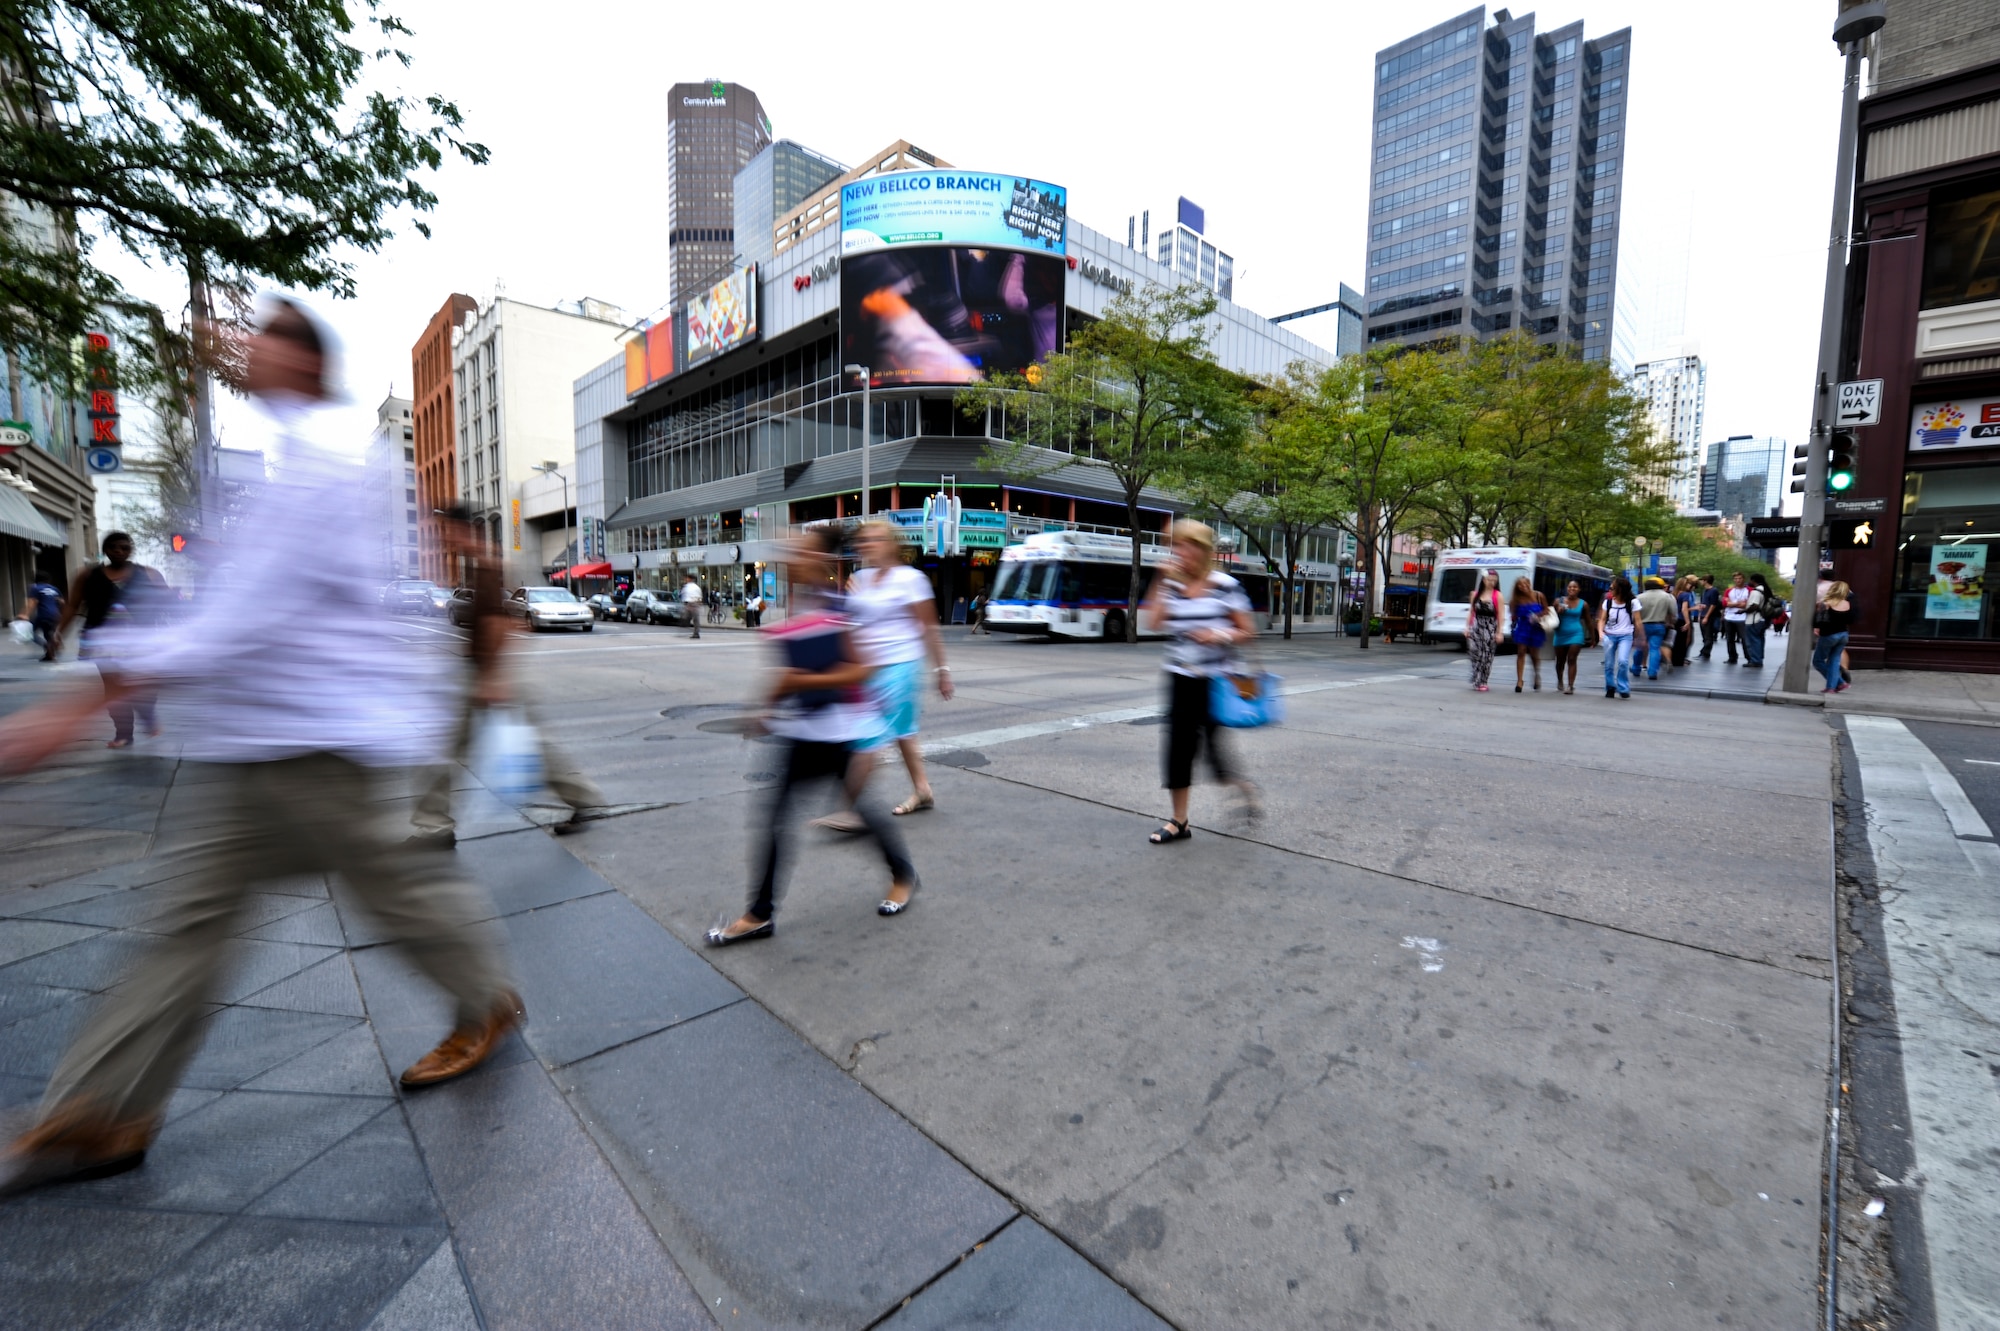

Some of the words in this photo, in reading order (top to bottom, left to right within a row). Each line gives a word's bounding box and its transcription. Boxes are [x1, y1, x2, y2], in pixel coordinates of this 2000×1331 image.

[683, 97, 726, 108] CenturyLink
[846, 183, 875, 203] NEW
[879, 176, 931, 194] BELLCO
[936, 176, 1002, 192] BRANCH
[846, 206, 862, 216] RIGHT
[864, 203, 878, 212] HERE
[846, 216, 862, 226] RIGHT
[864, 213, 880, 222] NOW
[1011, 204, 1039, 222] RIGHT
[1040, 215, 1061, 231] HERE
[1008, 215, 1036, 232] RIGHT
[1037, 227, 1061, 242] NOW
[1080, 257, 1131, 294] KeyBank
[1843, 384, 1875, 397] ONE
[1842, 396, 1875, 409] WAY
[1835, 501, 1877, 509] Champa
[1750, 526, 1785, 534] Famous
[962, 534, 999, 543] AVAILABLE
[1298, 564, 1319, 576] Payless
